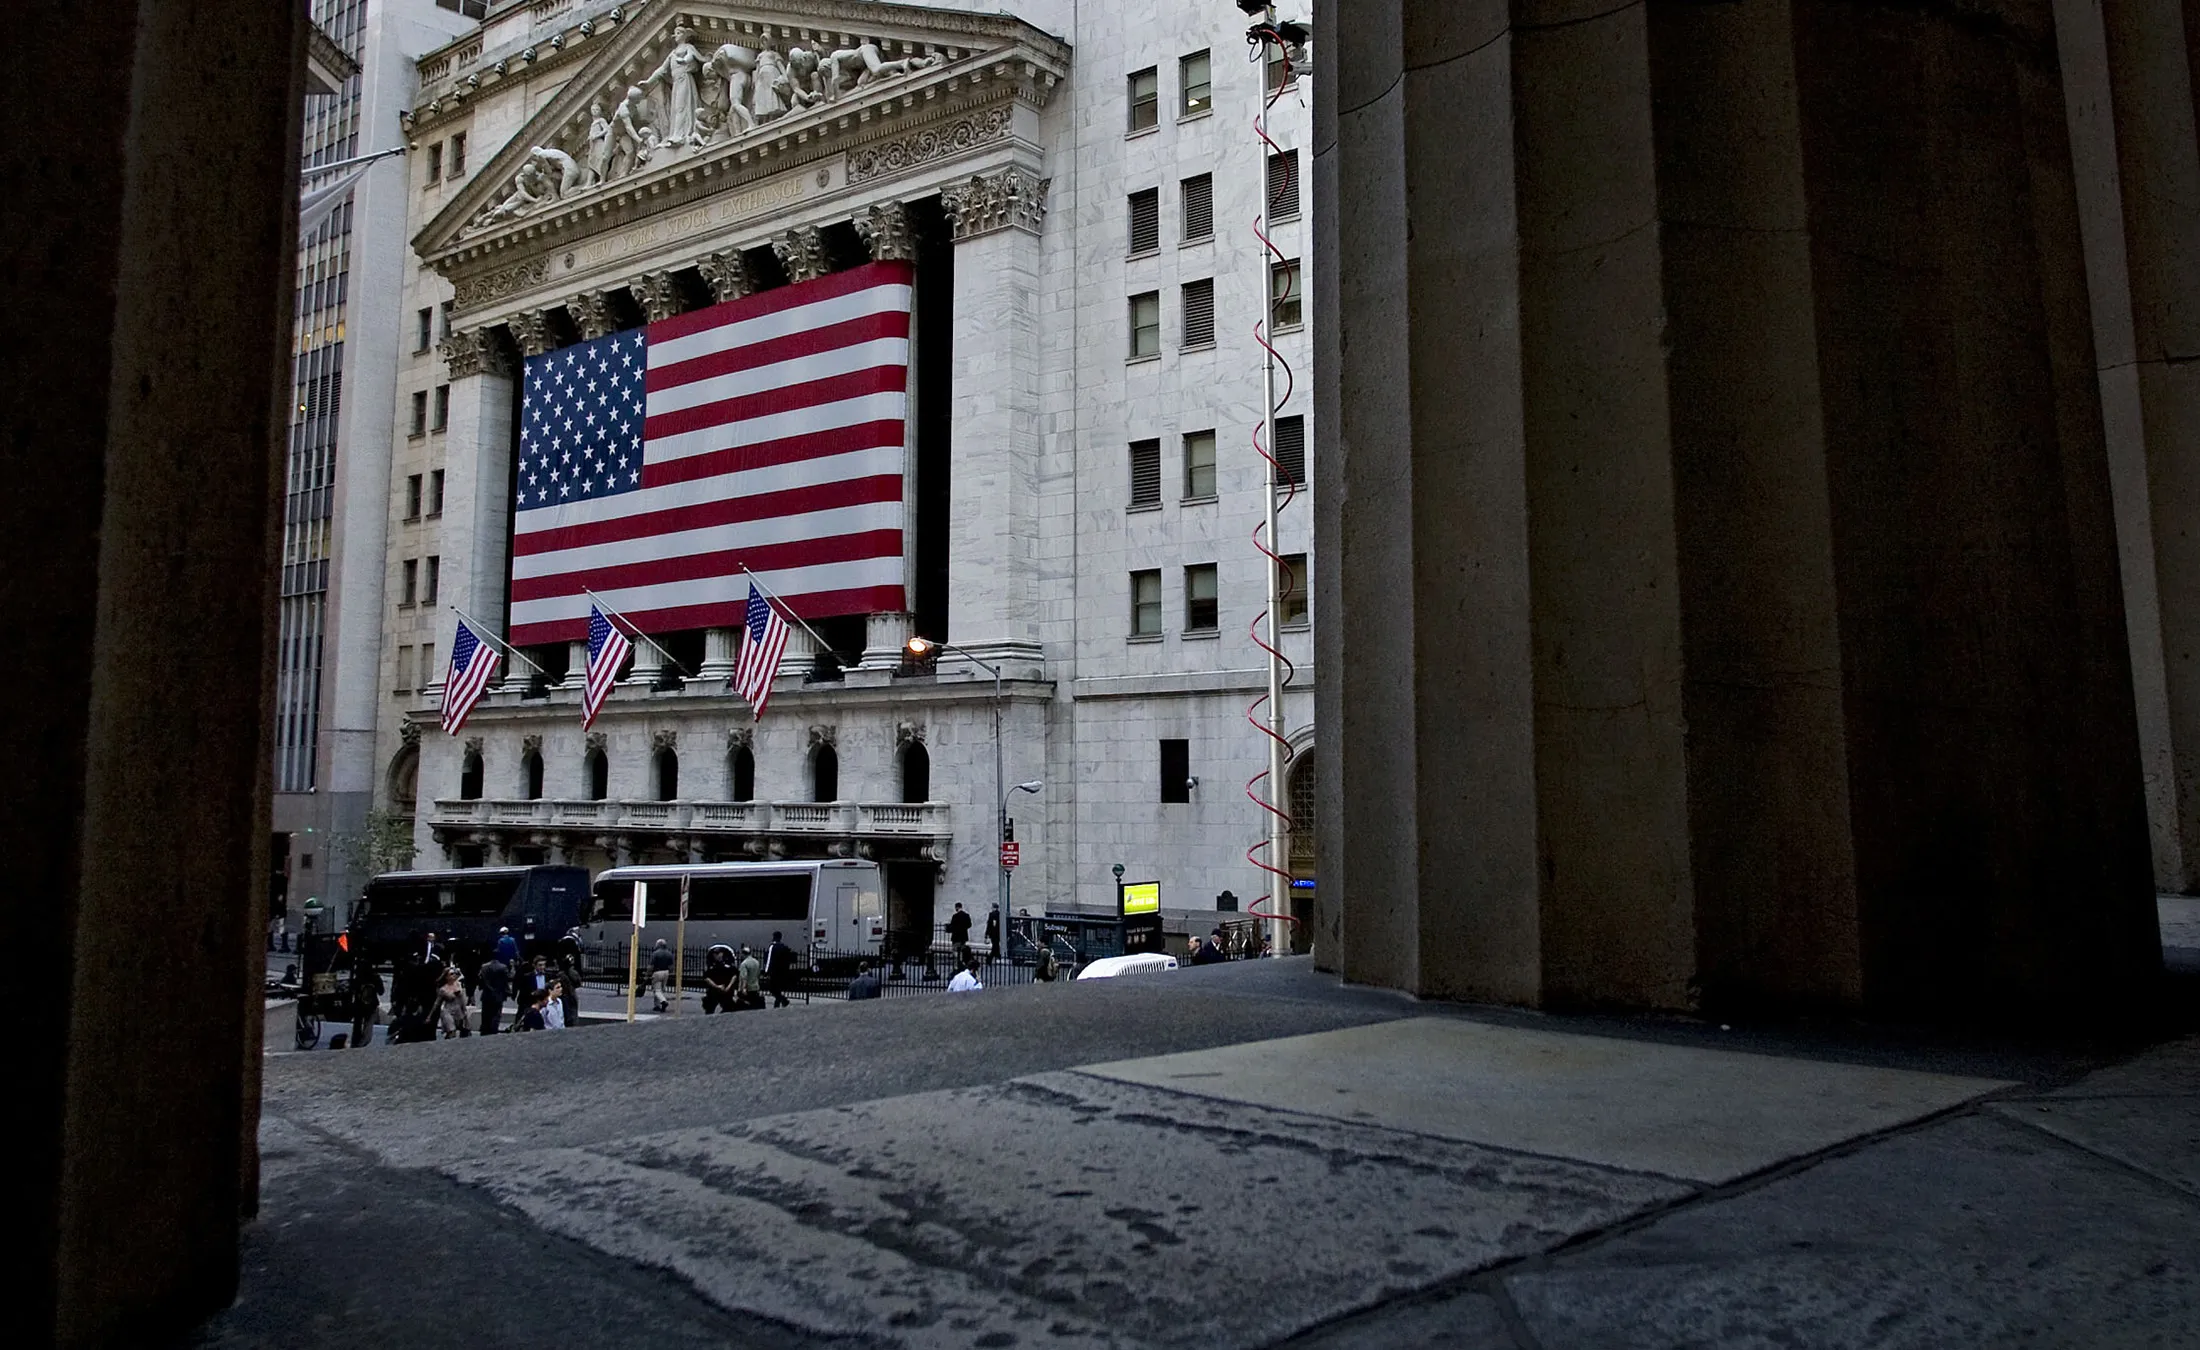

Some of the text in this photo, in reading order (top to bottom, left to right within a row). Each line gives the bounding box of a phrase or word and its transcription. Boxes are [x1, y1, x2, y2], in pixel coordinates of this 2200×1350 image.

[584, 178, 804, 264] NEW YORK STOCK EXCHANGE
